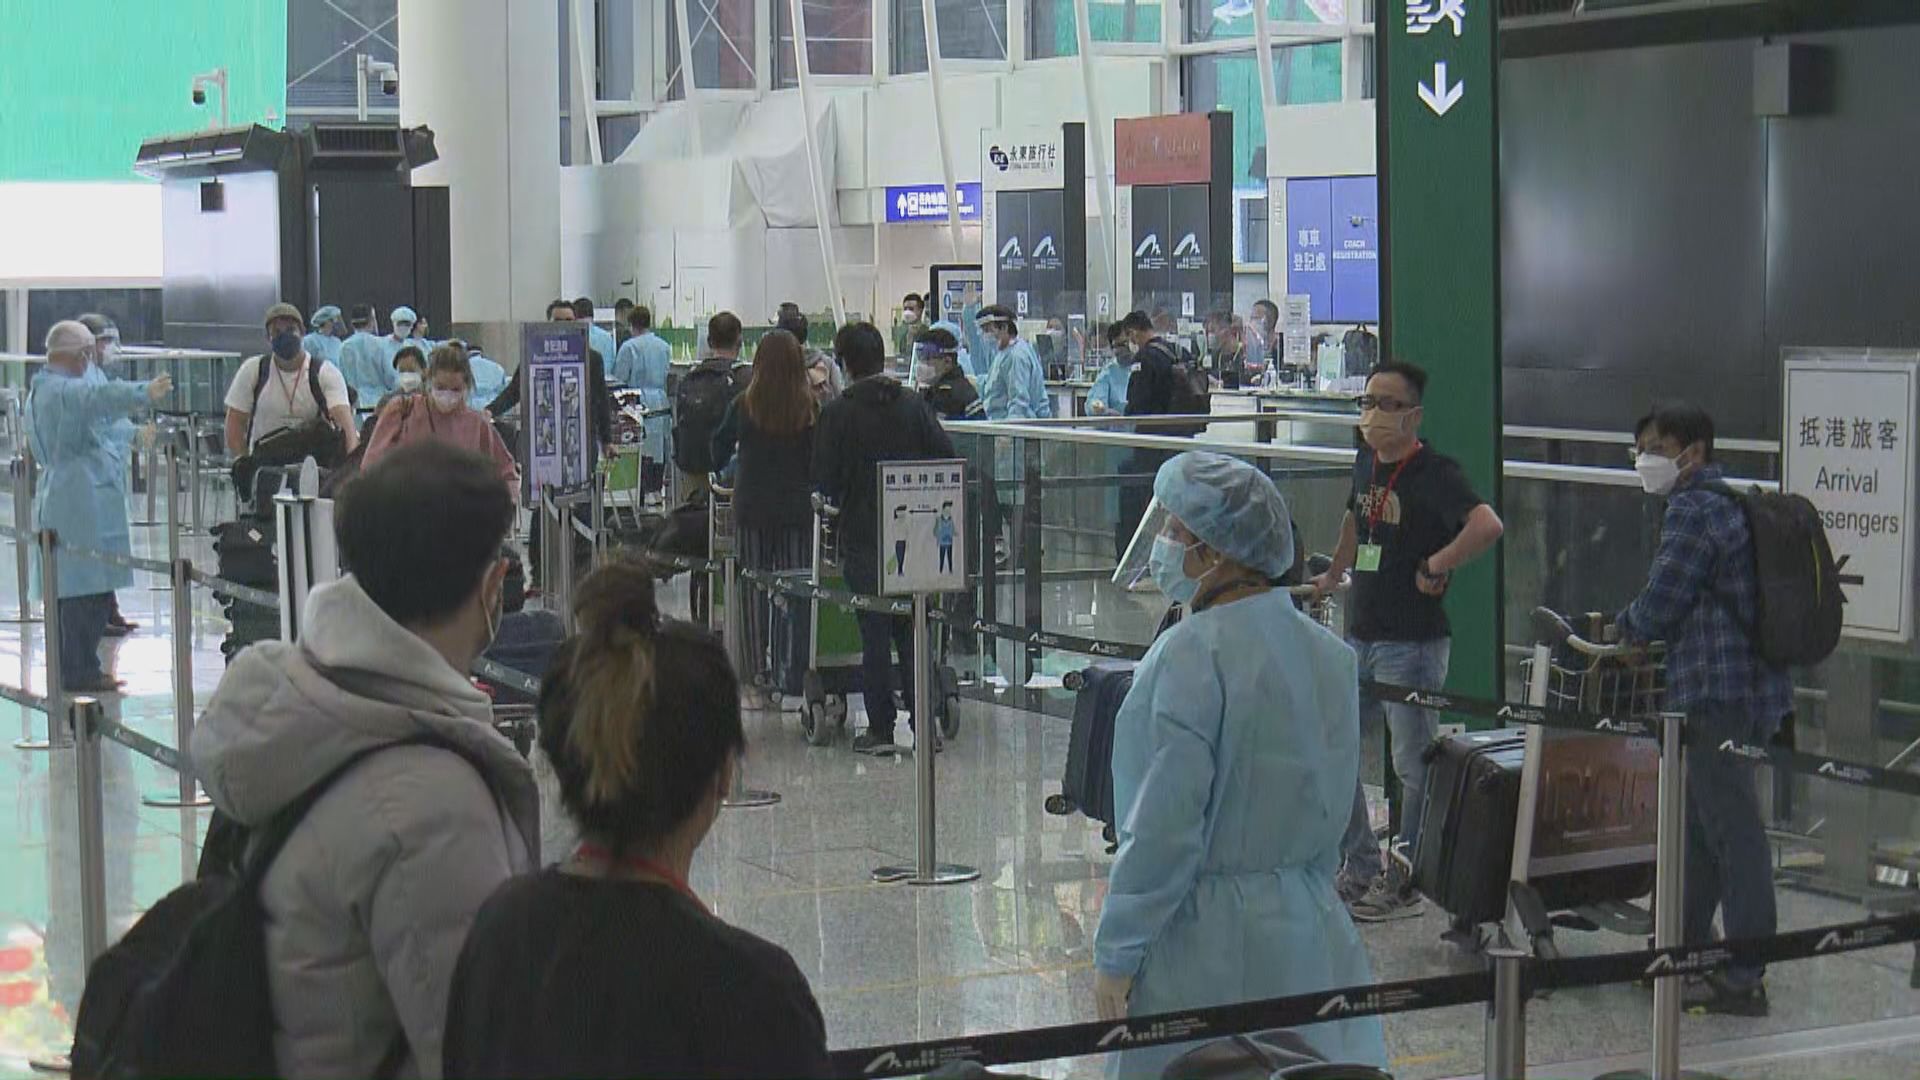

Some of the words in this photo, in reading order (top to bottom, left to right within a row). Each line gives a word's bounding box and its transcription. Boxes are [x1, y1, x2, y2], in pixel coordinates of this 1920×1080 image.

[1010, 143, 1056, 161] 永東旅行社
[1343, 240, 1366, 249] COACH
[1100, 296, 1107, 312] 2
[1799, 415, 1899, 451] 抵港旅客
[1814, 465, 1879, 495] Arrival
